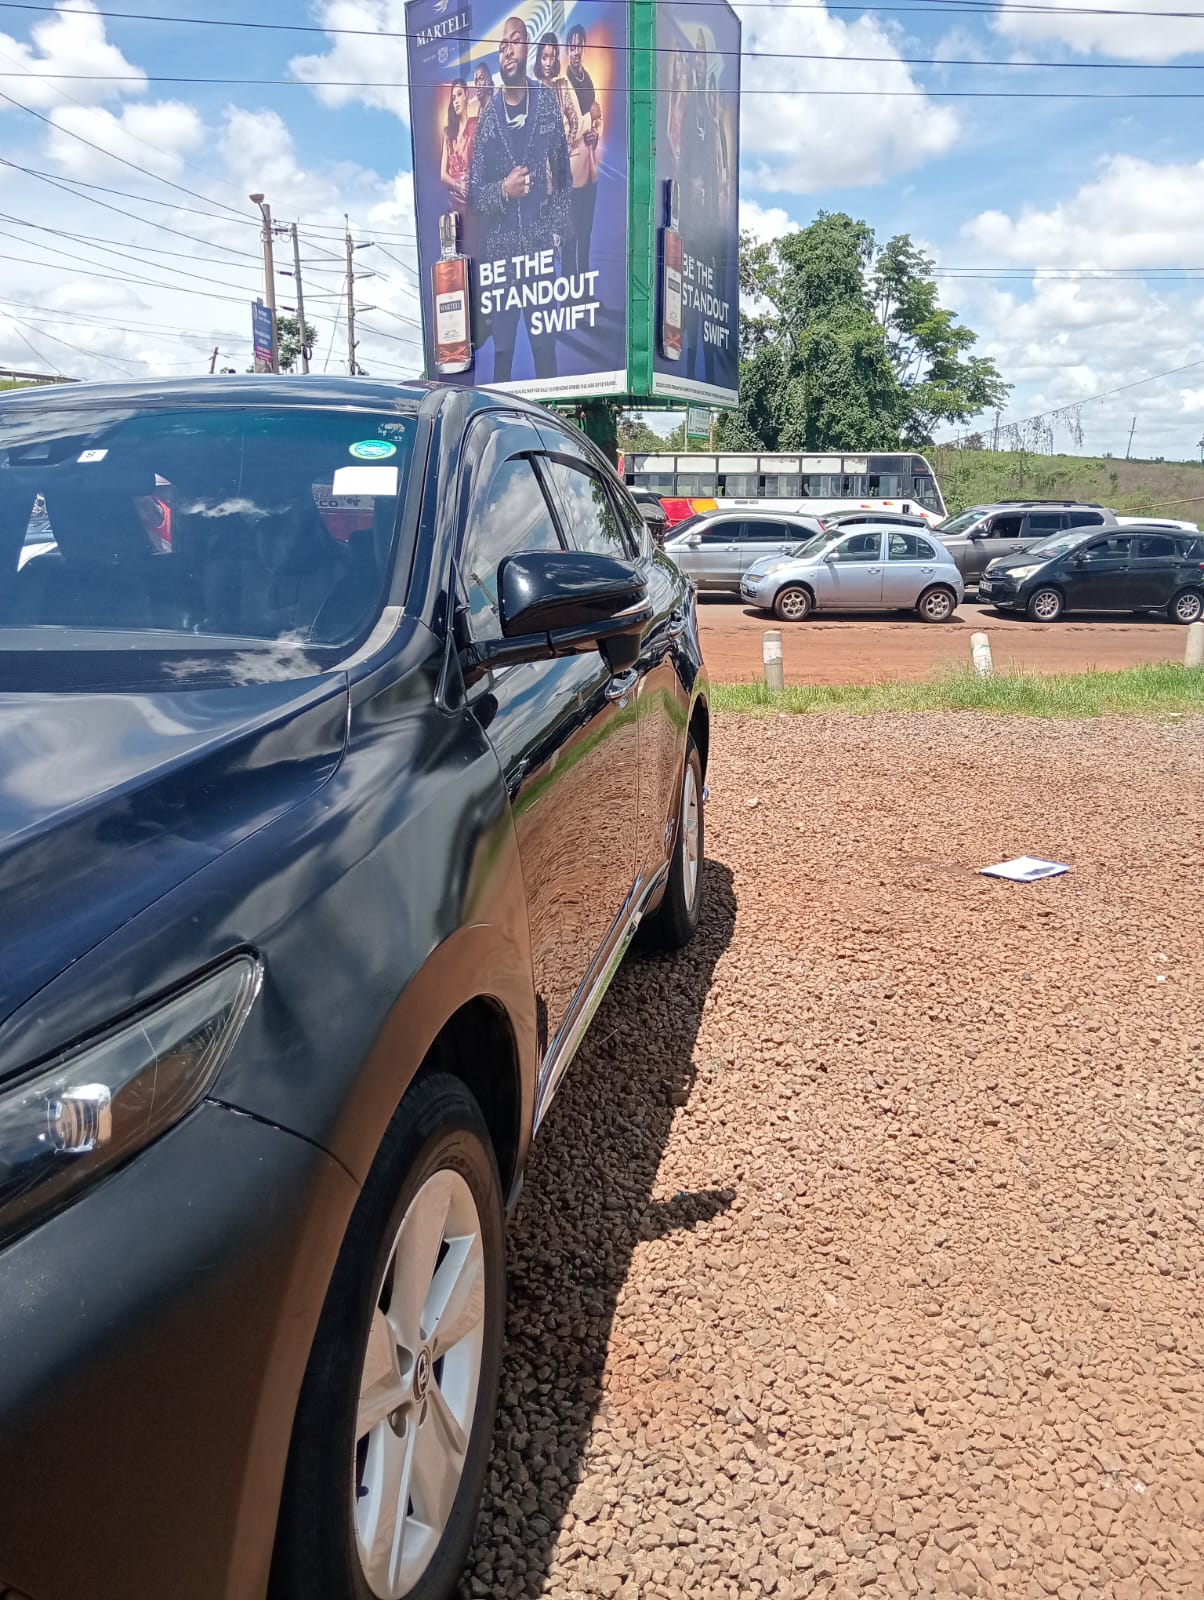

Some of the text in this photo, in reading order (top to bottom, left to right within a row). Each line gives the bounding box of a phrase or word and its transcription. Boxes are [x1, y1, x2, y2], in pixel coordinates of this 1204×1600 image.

[416, 13, 469, 47] MARTELL
[479, 249, 554, 287] BE THE
[683, 253, 694, 280] BE
[696, 260, 713, 290] THE
[480, 270, 599, 314] STANDOUT
[682, 282, 729, 323] STANDOUT
[530, 302, 600, 335] SWIFT
[703, 320, 730, 350] SWIFT
